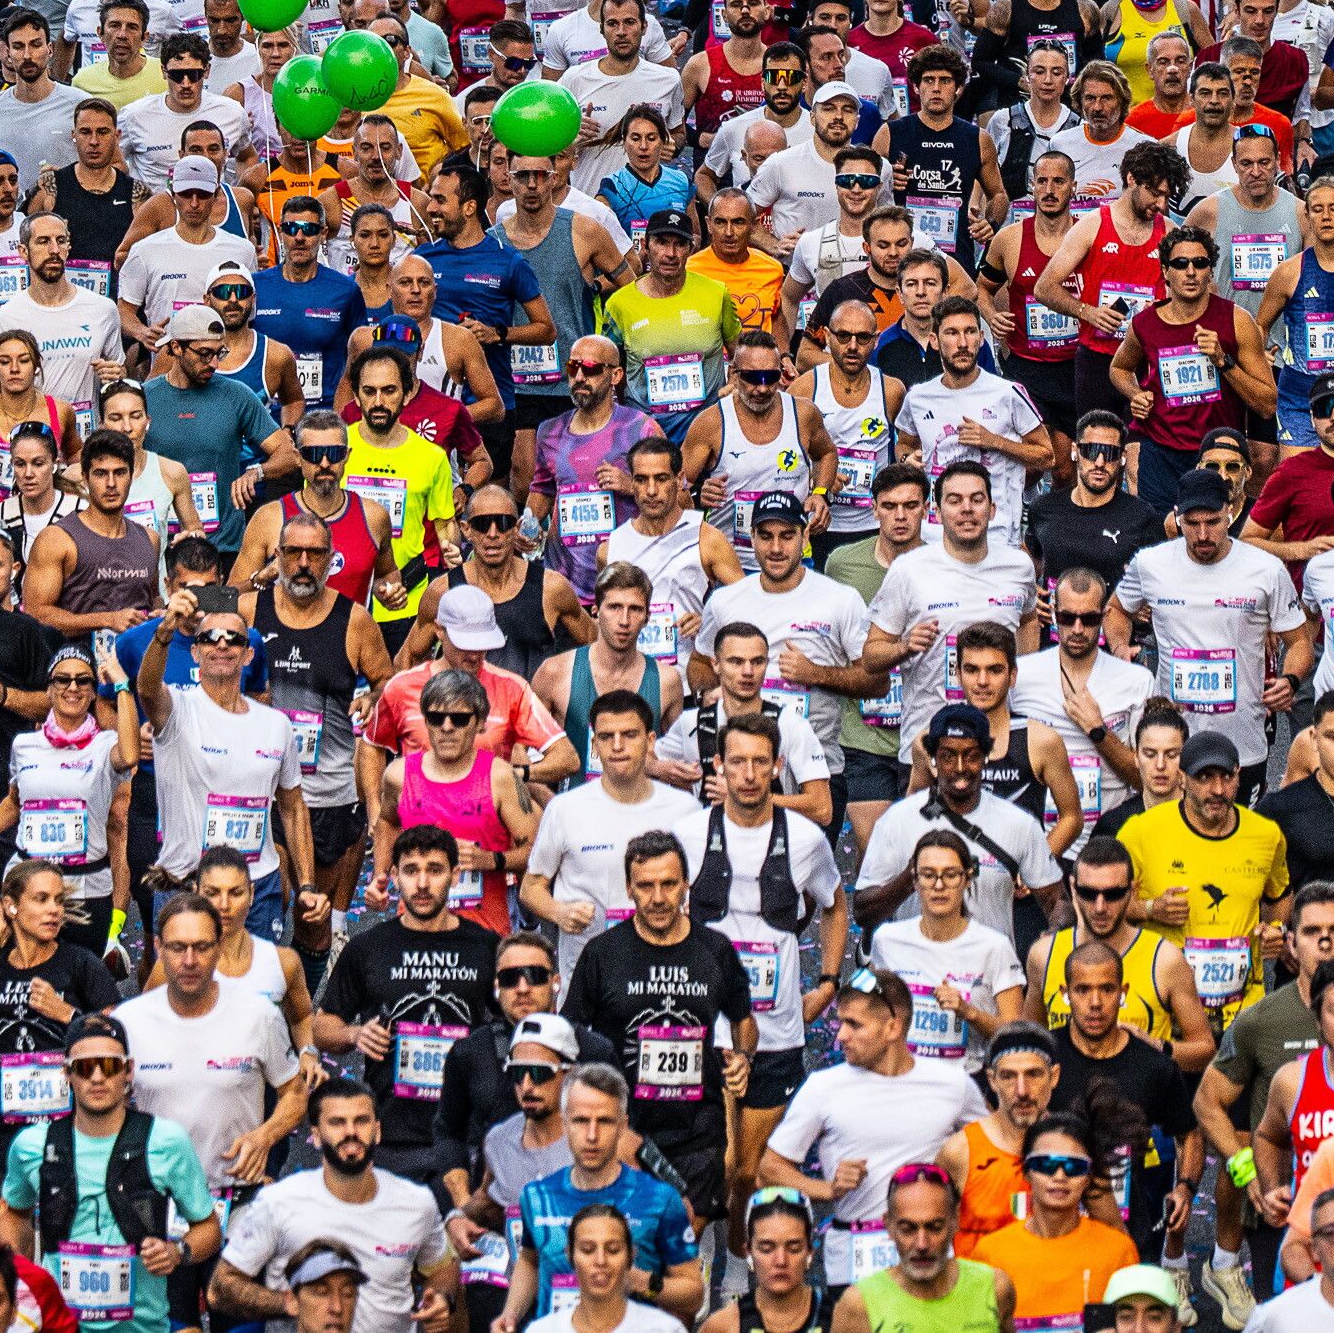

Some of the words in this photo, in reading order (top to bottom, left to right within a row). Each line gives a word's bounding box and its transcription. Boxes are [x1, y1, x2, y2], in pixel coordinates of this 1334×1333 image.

[922, 141, 955, 149] GIVOVA
[913, 167, 943, 180] Corsa
[941, 159, 952, 171] 17
[160, 273, 187, 281] BROOKS
[257, 308, 282, 316] BROOKS
[517, 345, 544, 364] 2442
[1175, 365, 1203, 384] 1921
[571, 504, 600, 522] 4155
[927, 602, 959, 611] BROOKS
[1157, 598, 1186, 606] BROOKS
[1187, 672, 1220, 691] 2788
[225, 817, 250, 840] 837
[581, 844, 614, 853] BROOKS
[402, 951, 459, 967] MANU
[390, 968, 409, 981] MI
[412, 963, 479, 982] MARATÓN
[649, 966, 689, 984] LUIS
[1202, 962, 1235, 983] 2521
[627, 983, 646, 995] MI
[649, 979, 709, 997] MARATÓN
[657, 1052, 689, 1073] 239
[18, 1079, 54, 1100] 3914
[658, 1087, 682, 1098] 2026
[79, 1271, 111, 1293] 960
[81, 1309, 106, 1320] 2026
